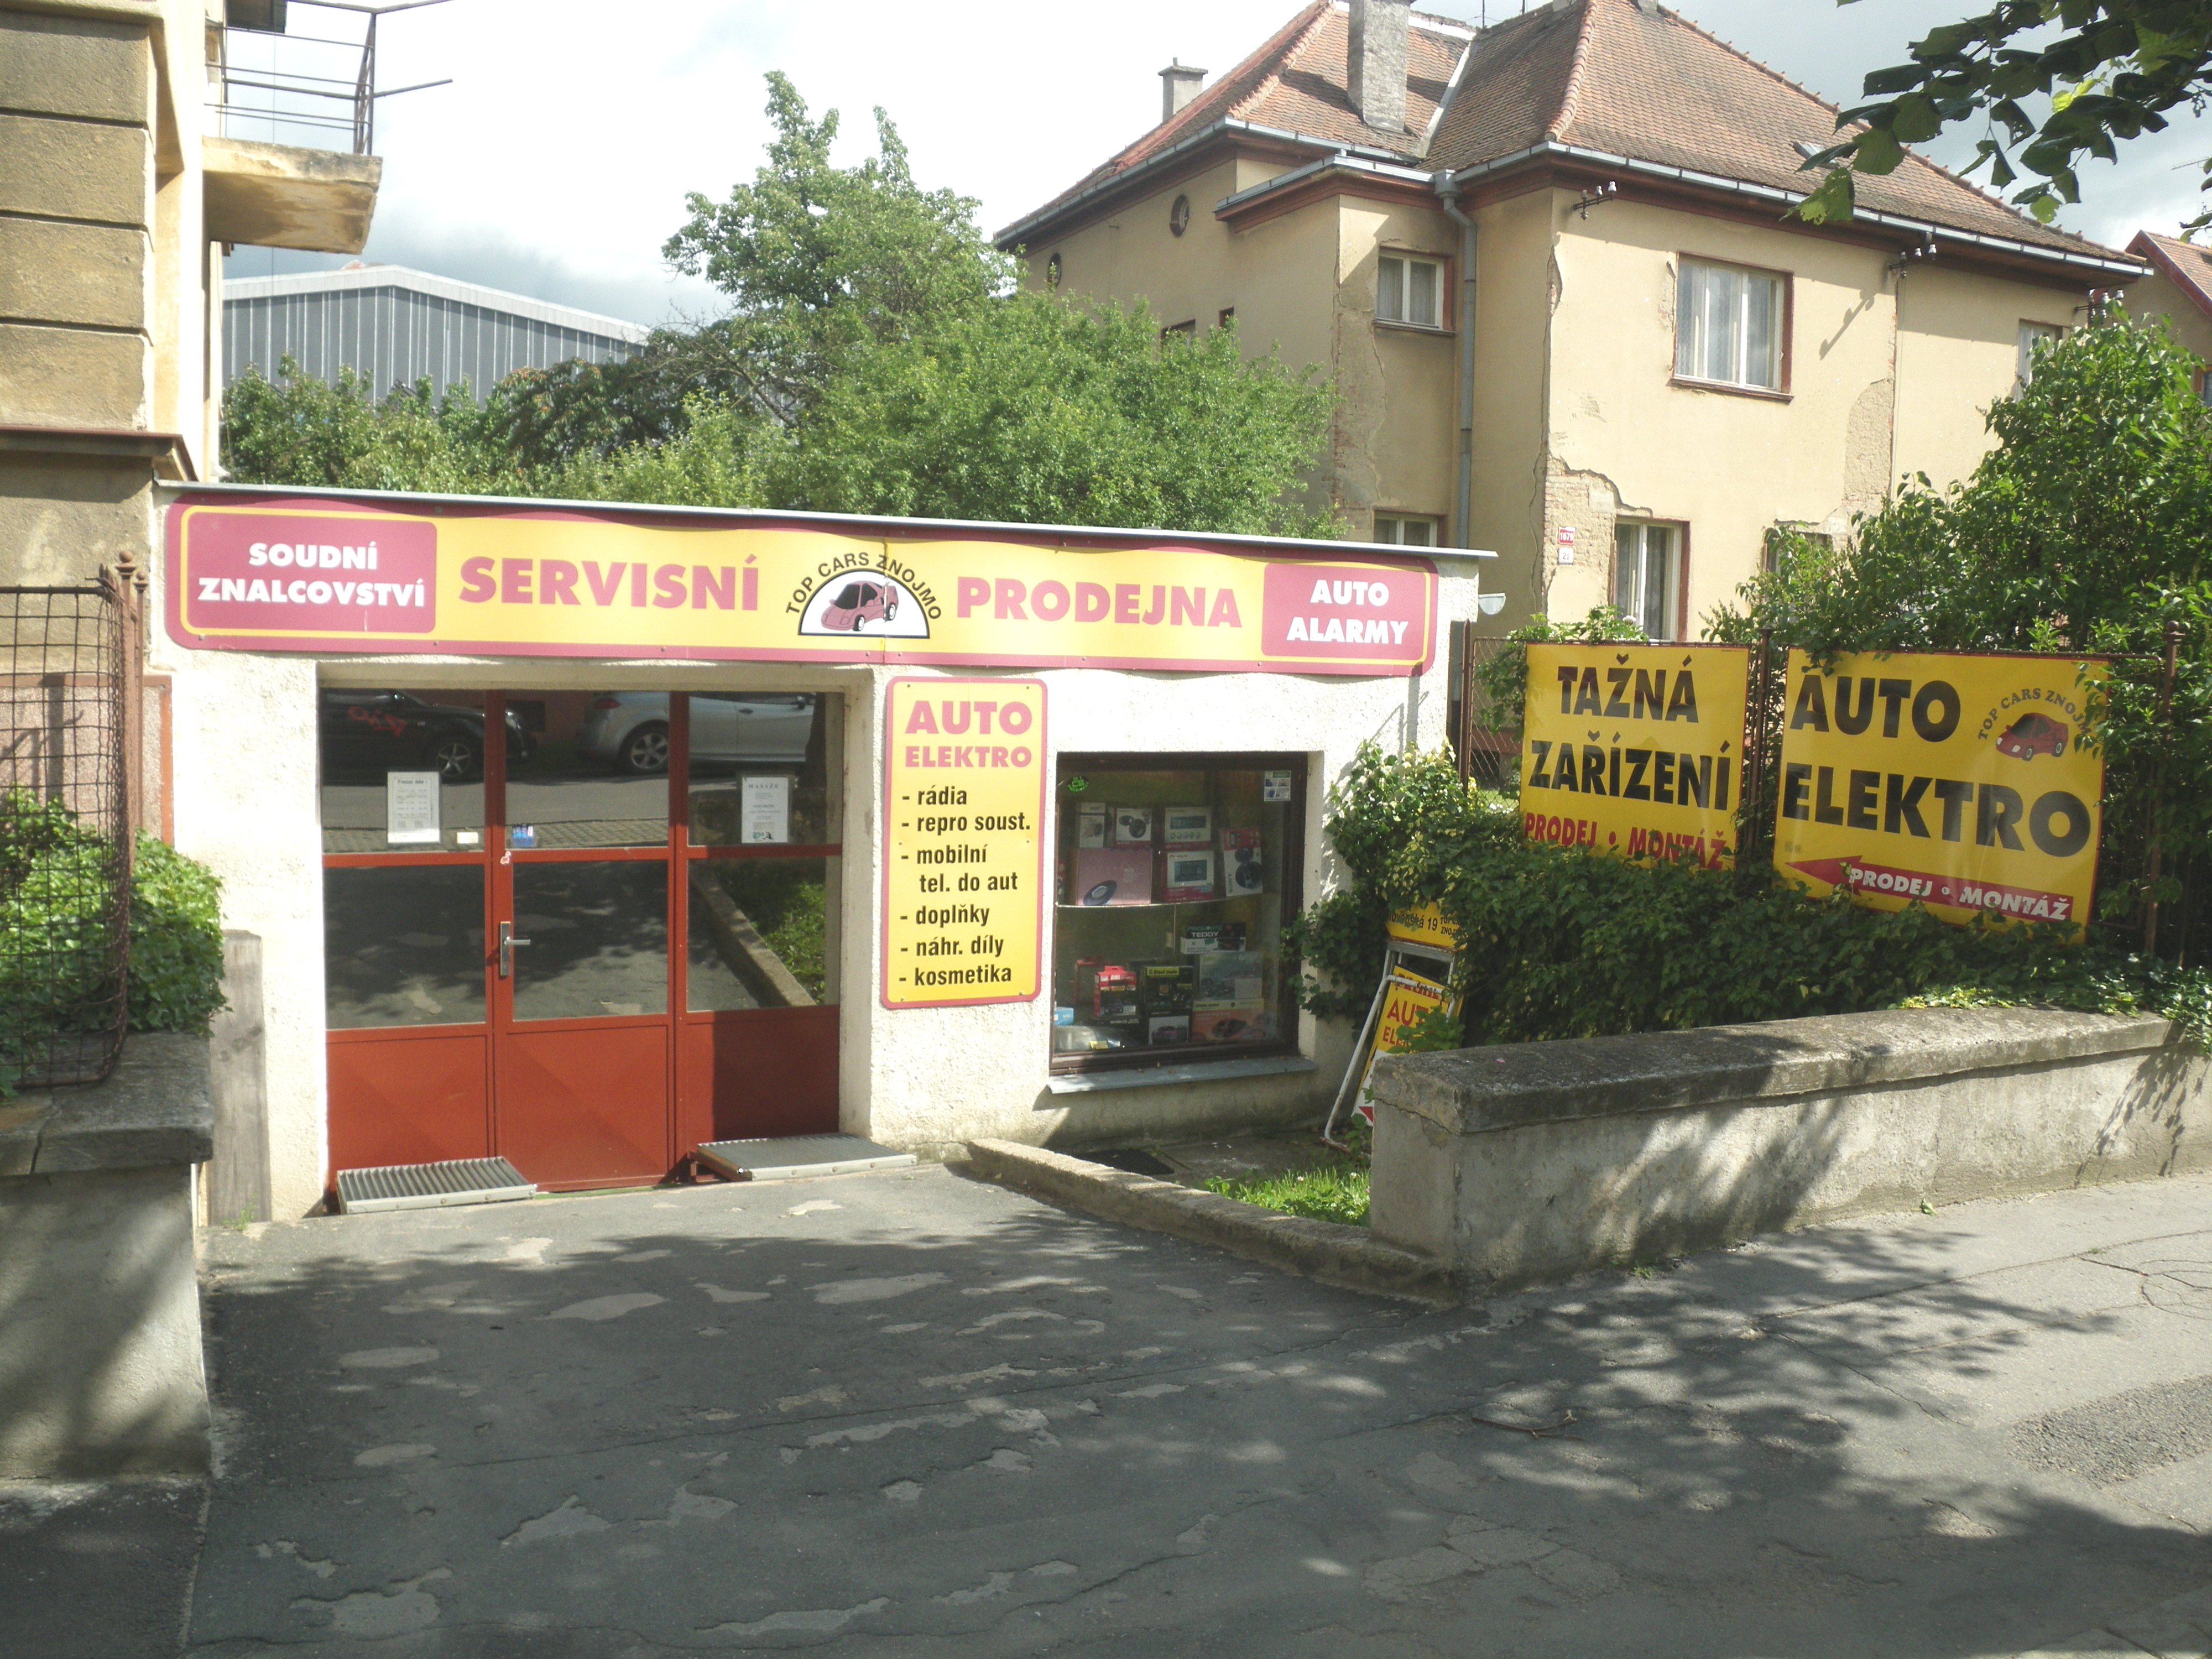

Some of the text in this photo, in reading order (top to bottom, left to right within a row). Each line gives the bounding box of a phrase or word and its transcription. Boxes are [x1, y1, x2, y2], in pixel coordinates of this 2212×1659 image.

[1560, 532, 1573, 541] 1679
[248, 541, 377, 570] SOUDNÍ
[197, 577, 424, 607] ZNALCOVSTVÍ
[458, 554, 759, 611] SERVISNÍ
[785, 552, 941, 619] TOP CARS ZNOJMO
[1310, 579, 1389, 607] AUTO
[957, 576, 1242, 628] PRODEJNA
[1286, 615, 1409, 645] ALARMY
[1557, 653, 1699, 723] TAŽNÁ
[905, 700, 1032, 735] AUTO
[1790, 675, 1961, 743] AUTO
[1978, 687, 2091, 740] TOP CARS ZNOJM
[905, 745, 1032, 768] ELEKTRO
[1528, 729, 1730, 811] ZAŘÍZENÍ
[917, 784, 967, 805] rádia
[916, 816, 967, 836] repro
[974, 812, 1031, 831] soust.
[1782, 762, 2091, 858] ELEKTRO
[916, 844, 989, 865] mobilní
[1524, 812, 1726, 871] PRODEJ MONTÁŽ
[919, 872, 1018, 893] tel. do aut
[1849, 868, 2070, 921] PRODEJ MONTÁŽ
[915, 903, 990, 928] doplňky
[1428, 917, 1438, 931] 19
[916, 936, 963, 957] náhr.
[970, 935, 1004, 959] díly
[914, 964, 1012, 986] kosmetika
[1386, 998, 1429, 1027] AUT
